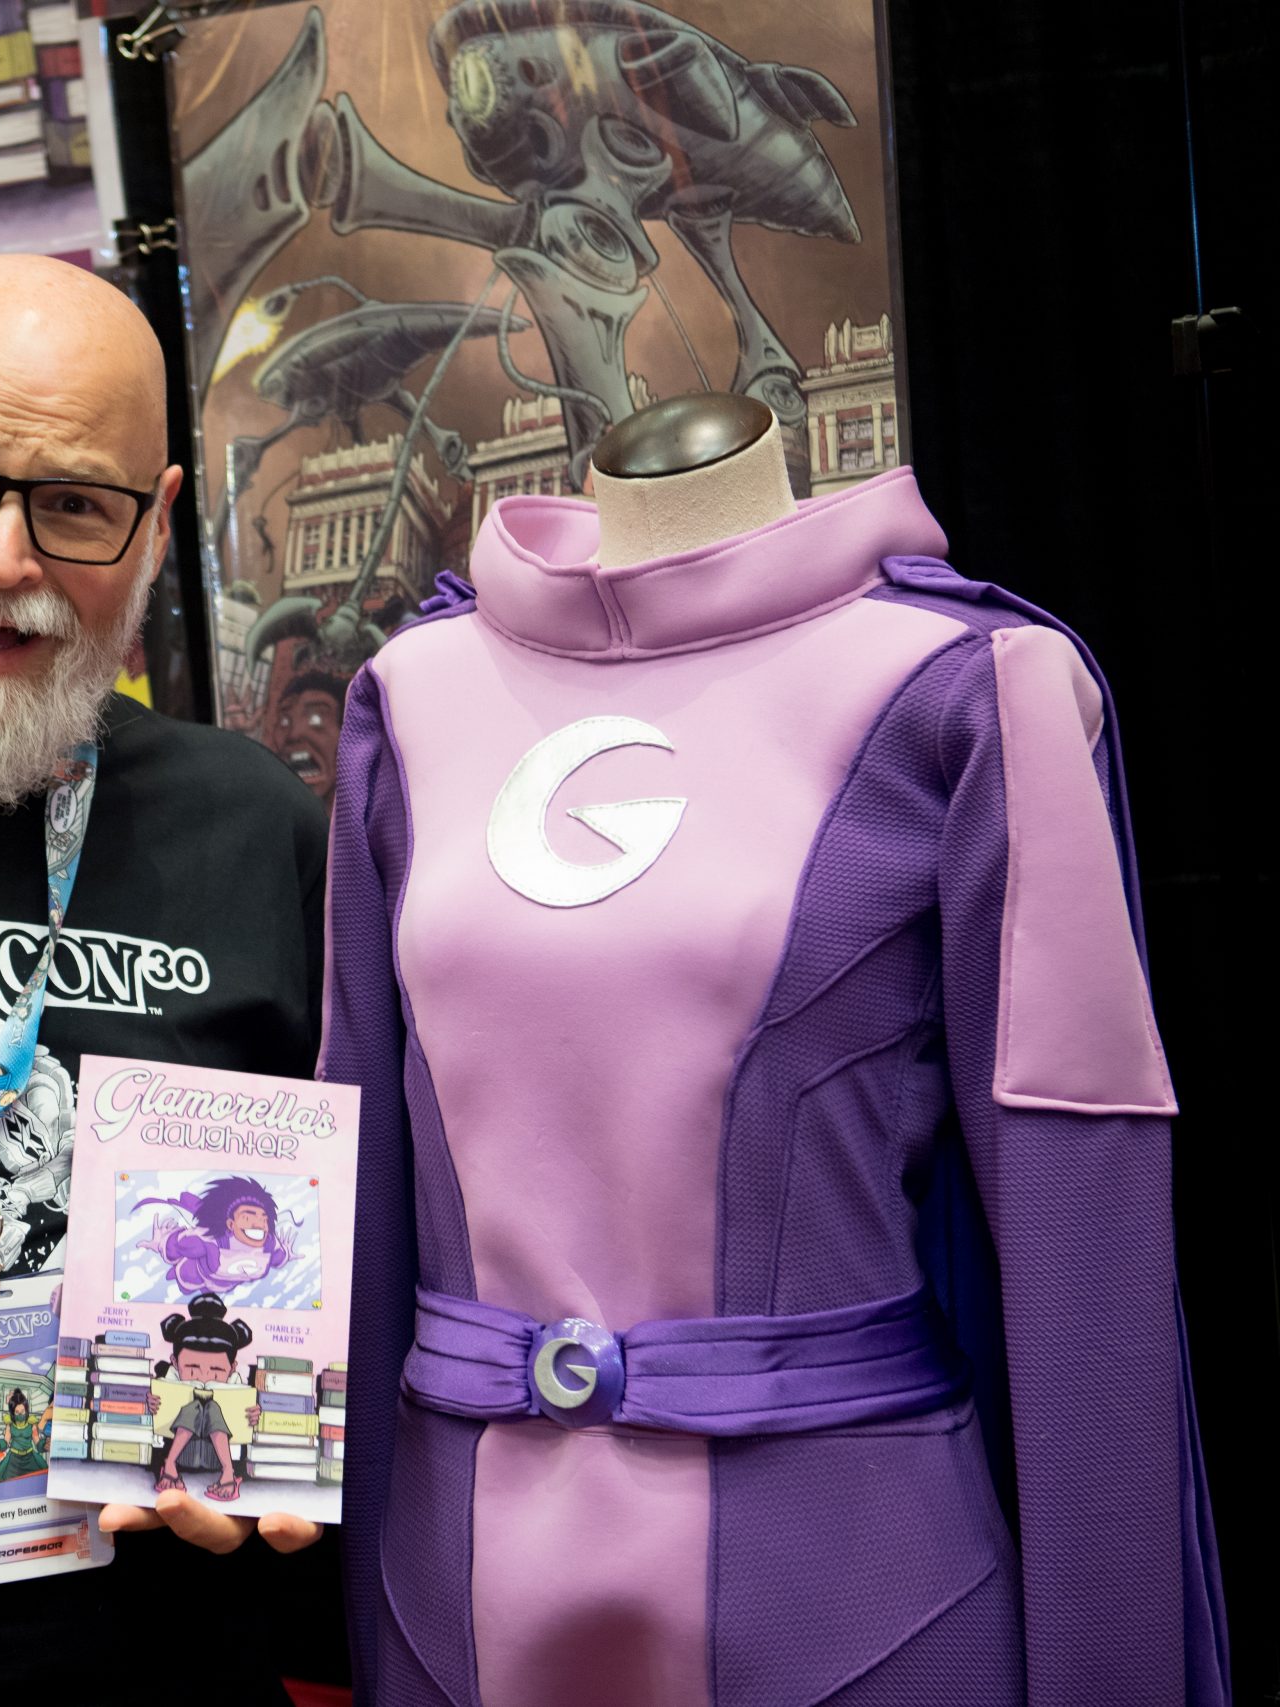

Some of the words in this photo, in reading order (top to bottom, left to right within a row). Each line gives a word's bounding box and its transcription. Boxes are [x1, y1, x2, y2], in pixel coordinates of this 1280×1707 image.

[487, 714, 688, 909] G
[90, 1067, 337, 1143] Glamorella's
[103, 1306, 130, 1316] JERRY
[97, 1316, 134, 1327] BENNETT
[265, 1323, 301, 1335] CHARLES
[272, 1334, 305, 1345] MARTIN
[17, 1503, 48, 1516] Bennett
